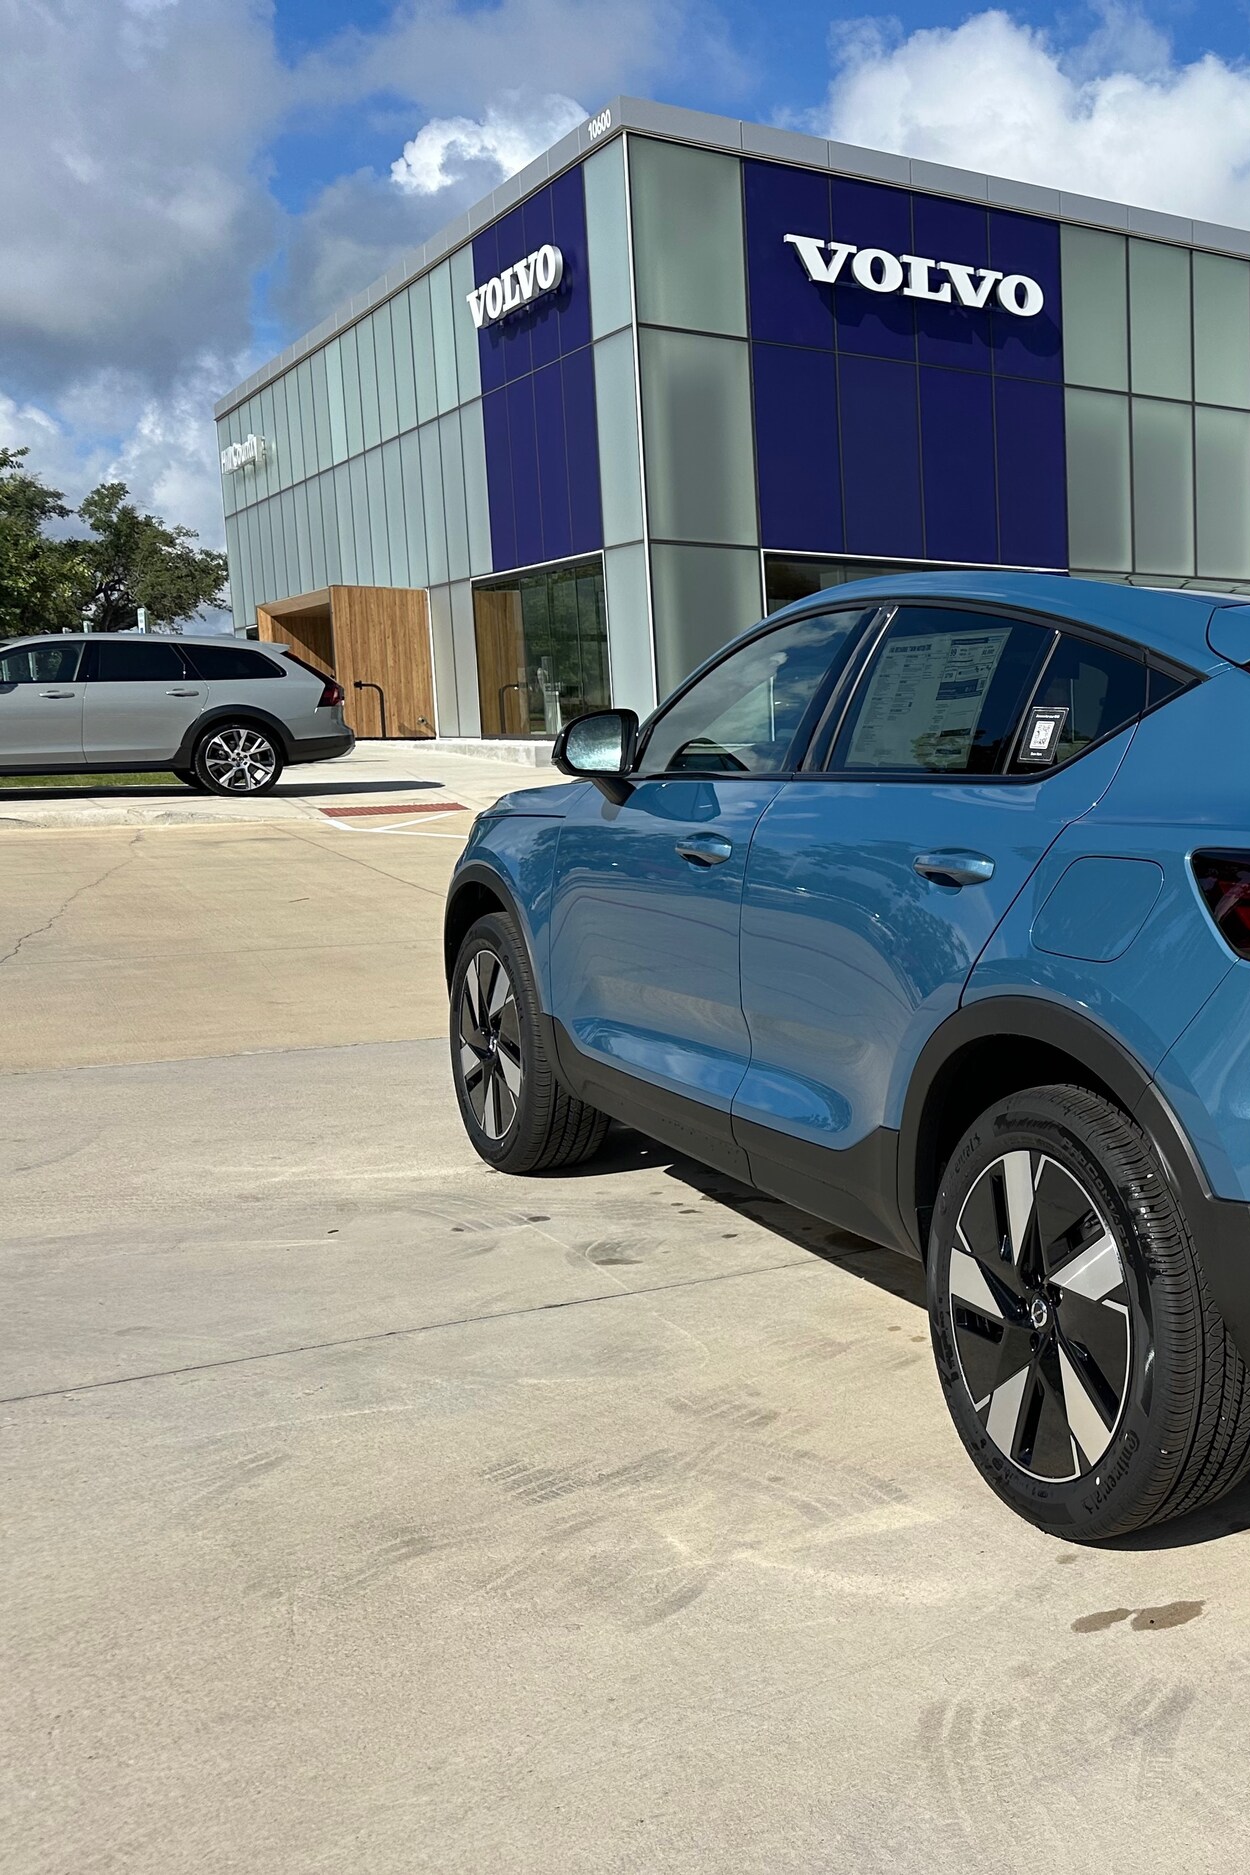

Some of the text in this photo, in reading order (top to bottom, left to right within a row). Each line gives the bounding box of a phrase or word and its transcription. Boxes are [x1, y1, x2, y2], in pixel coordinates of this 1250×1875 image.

[588, 109, 611, 140] 10600
[466, 244, 561, 329] VOLVO
[783, 233, 1044, 317] VOLVO
